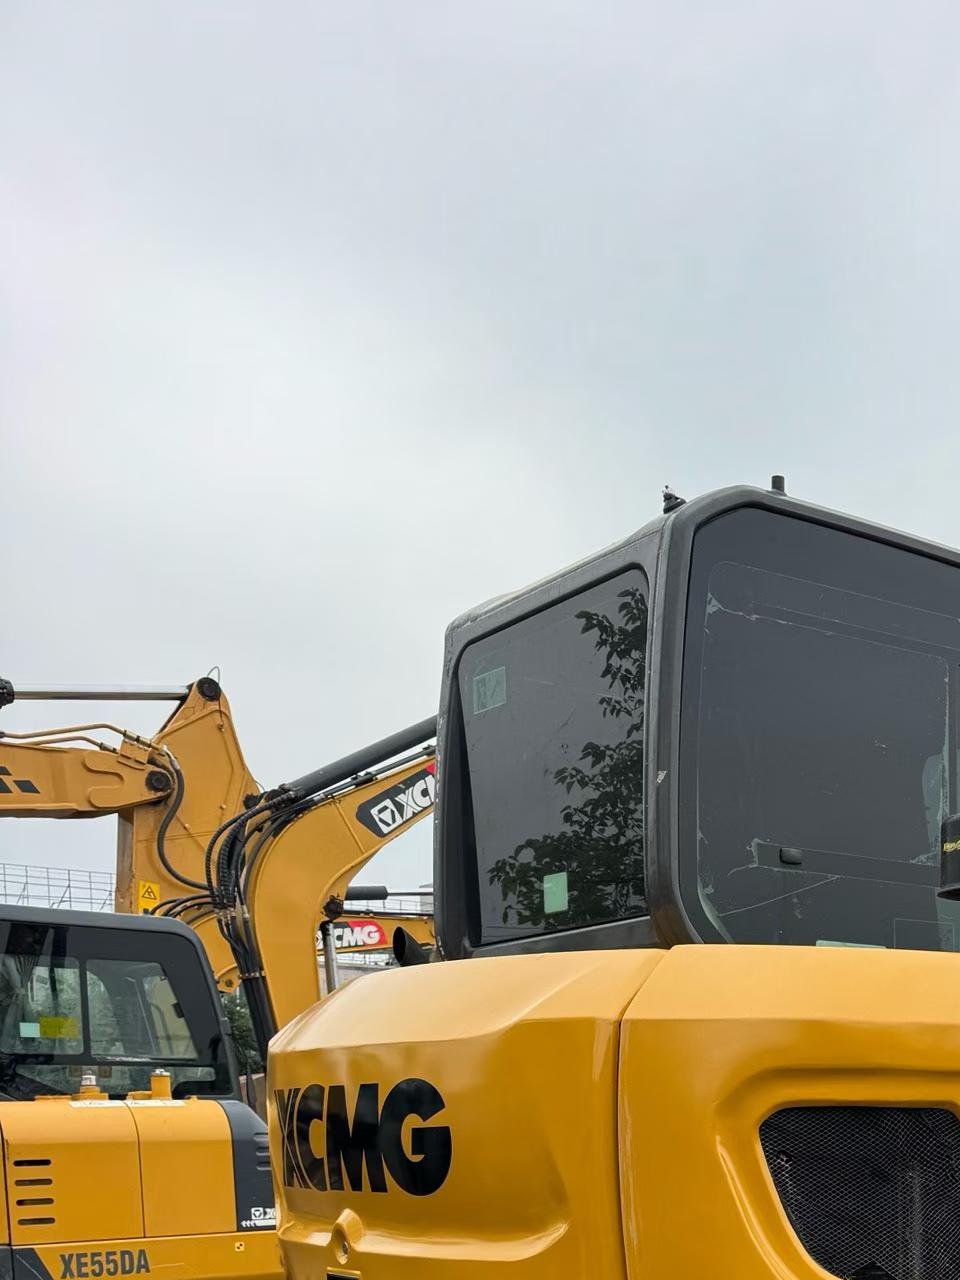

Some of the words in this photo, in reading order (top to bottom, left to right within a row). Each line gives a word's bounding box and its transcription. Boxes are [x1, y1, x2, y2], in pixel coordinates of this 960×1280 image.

[334, 925, 380, 948] CMG
[274, 1077, 452, 1197] XCMG
[60, 1249, 151, 1280] XE55DA
